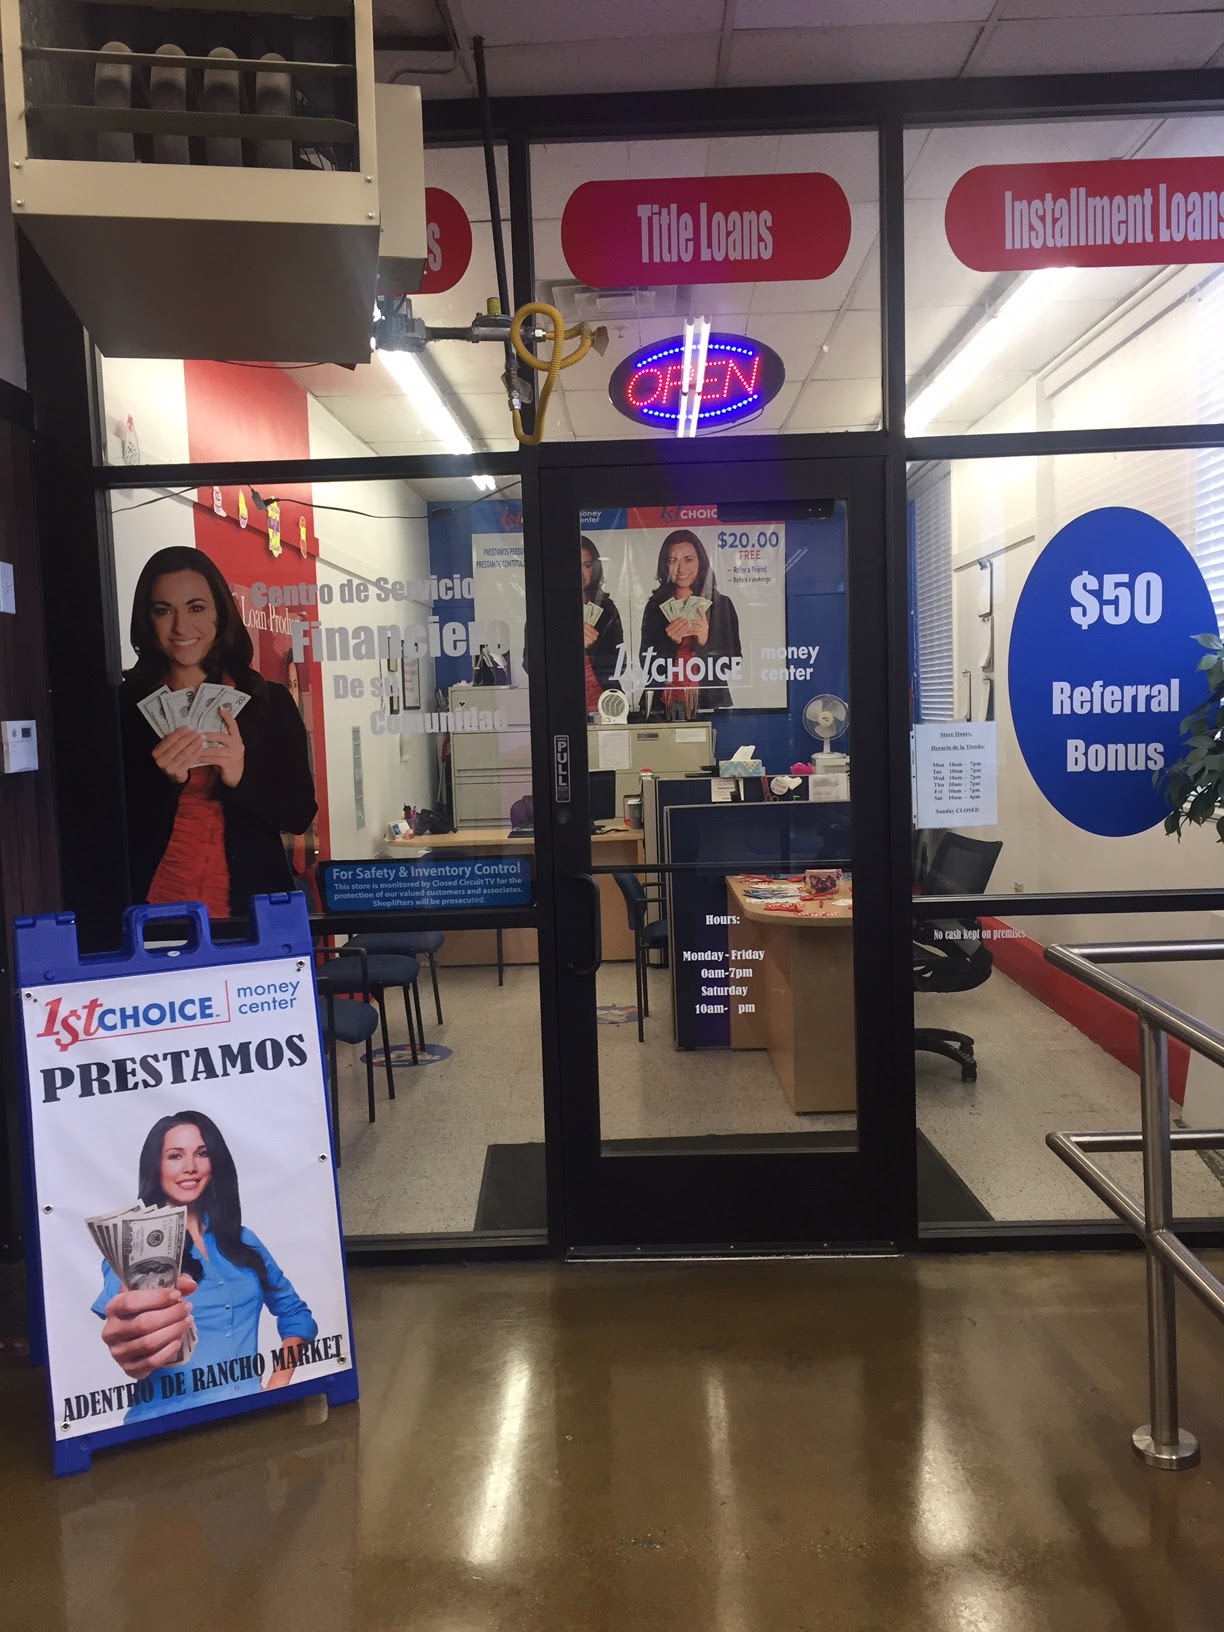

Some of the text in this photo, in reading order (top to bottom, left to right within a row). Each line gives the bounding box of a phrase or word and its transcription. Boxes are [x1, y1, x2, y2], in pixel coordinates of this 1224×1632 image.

[1005, 187, 1153, 249] Installment
[637, 202, 773, 263] Title Loans
[627, 356, 760, 406] OPEN
[717, 530, 779, 550] $20.00
[739, 549, 761, 560] FREE
[751, 564, 767, 574] Friend
[251, 574, 474, 608] Centro de Servicio
[1070, 570, 1164, 630] $50
[240, 595, 268, 631] Loan
[291, 615, 511, 663] Financiero
[760, 645, 820, 663] money
[760, 666, 814, 682] center
[334, 674, 363, 699] De
[370, 676, 400, 698] su
[1052, 678, 1180, 715] Referral
[370, 706, 507, 736] Comunidad
[557, 741, 568, 786] PULL
[1066, 739, 1165, 772] Bonus
[333, 861, 521, 881] For Safety & Inventory Control
[334, 892, 374, 900] protection
[399, 889, 425, 897] valued
[426, 888, 466, 897] customers
[467, 887, 481, 895] and
[482, 886, 524, 894] associates.
[351, 882, 371, 890] store
[379, 881, 420, 889] monitored
[421, 880, 431, 889] by
[432, 879, 457, 887] Closed
[459, 878, 484, 886] Circuit
[485, 878, 496, 886] TV
[497, 877, 508, 885] for
[509, 876, 522, 884] the
[373, 899, 414, 908] Shoplifters
[442, 896, 486, 906] prosecuted.
[705, 914, 741, 925] Hours:
[933, 928, 1025, 940] No cash kept on premises
[237, 980, 301, 998] money
[701, 985, 748, 996] Saturday
[238, 995, 298, 1015] center
[738, 1003, 755, 1014] pm
[39, 1033, 308, 1104] PRESTAMOS
[62, 1334, 344, 1423] ADENTRO DE RANCHO MARKET
